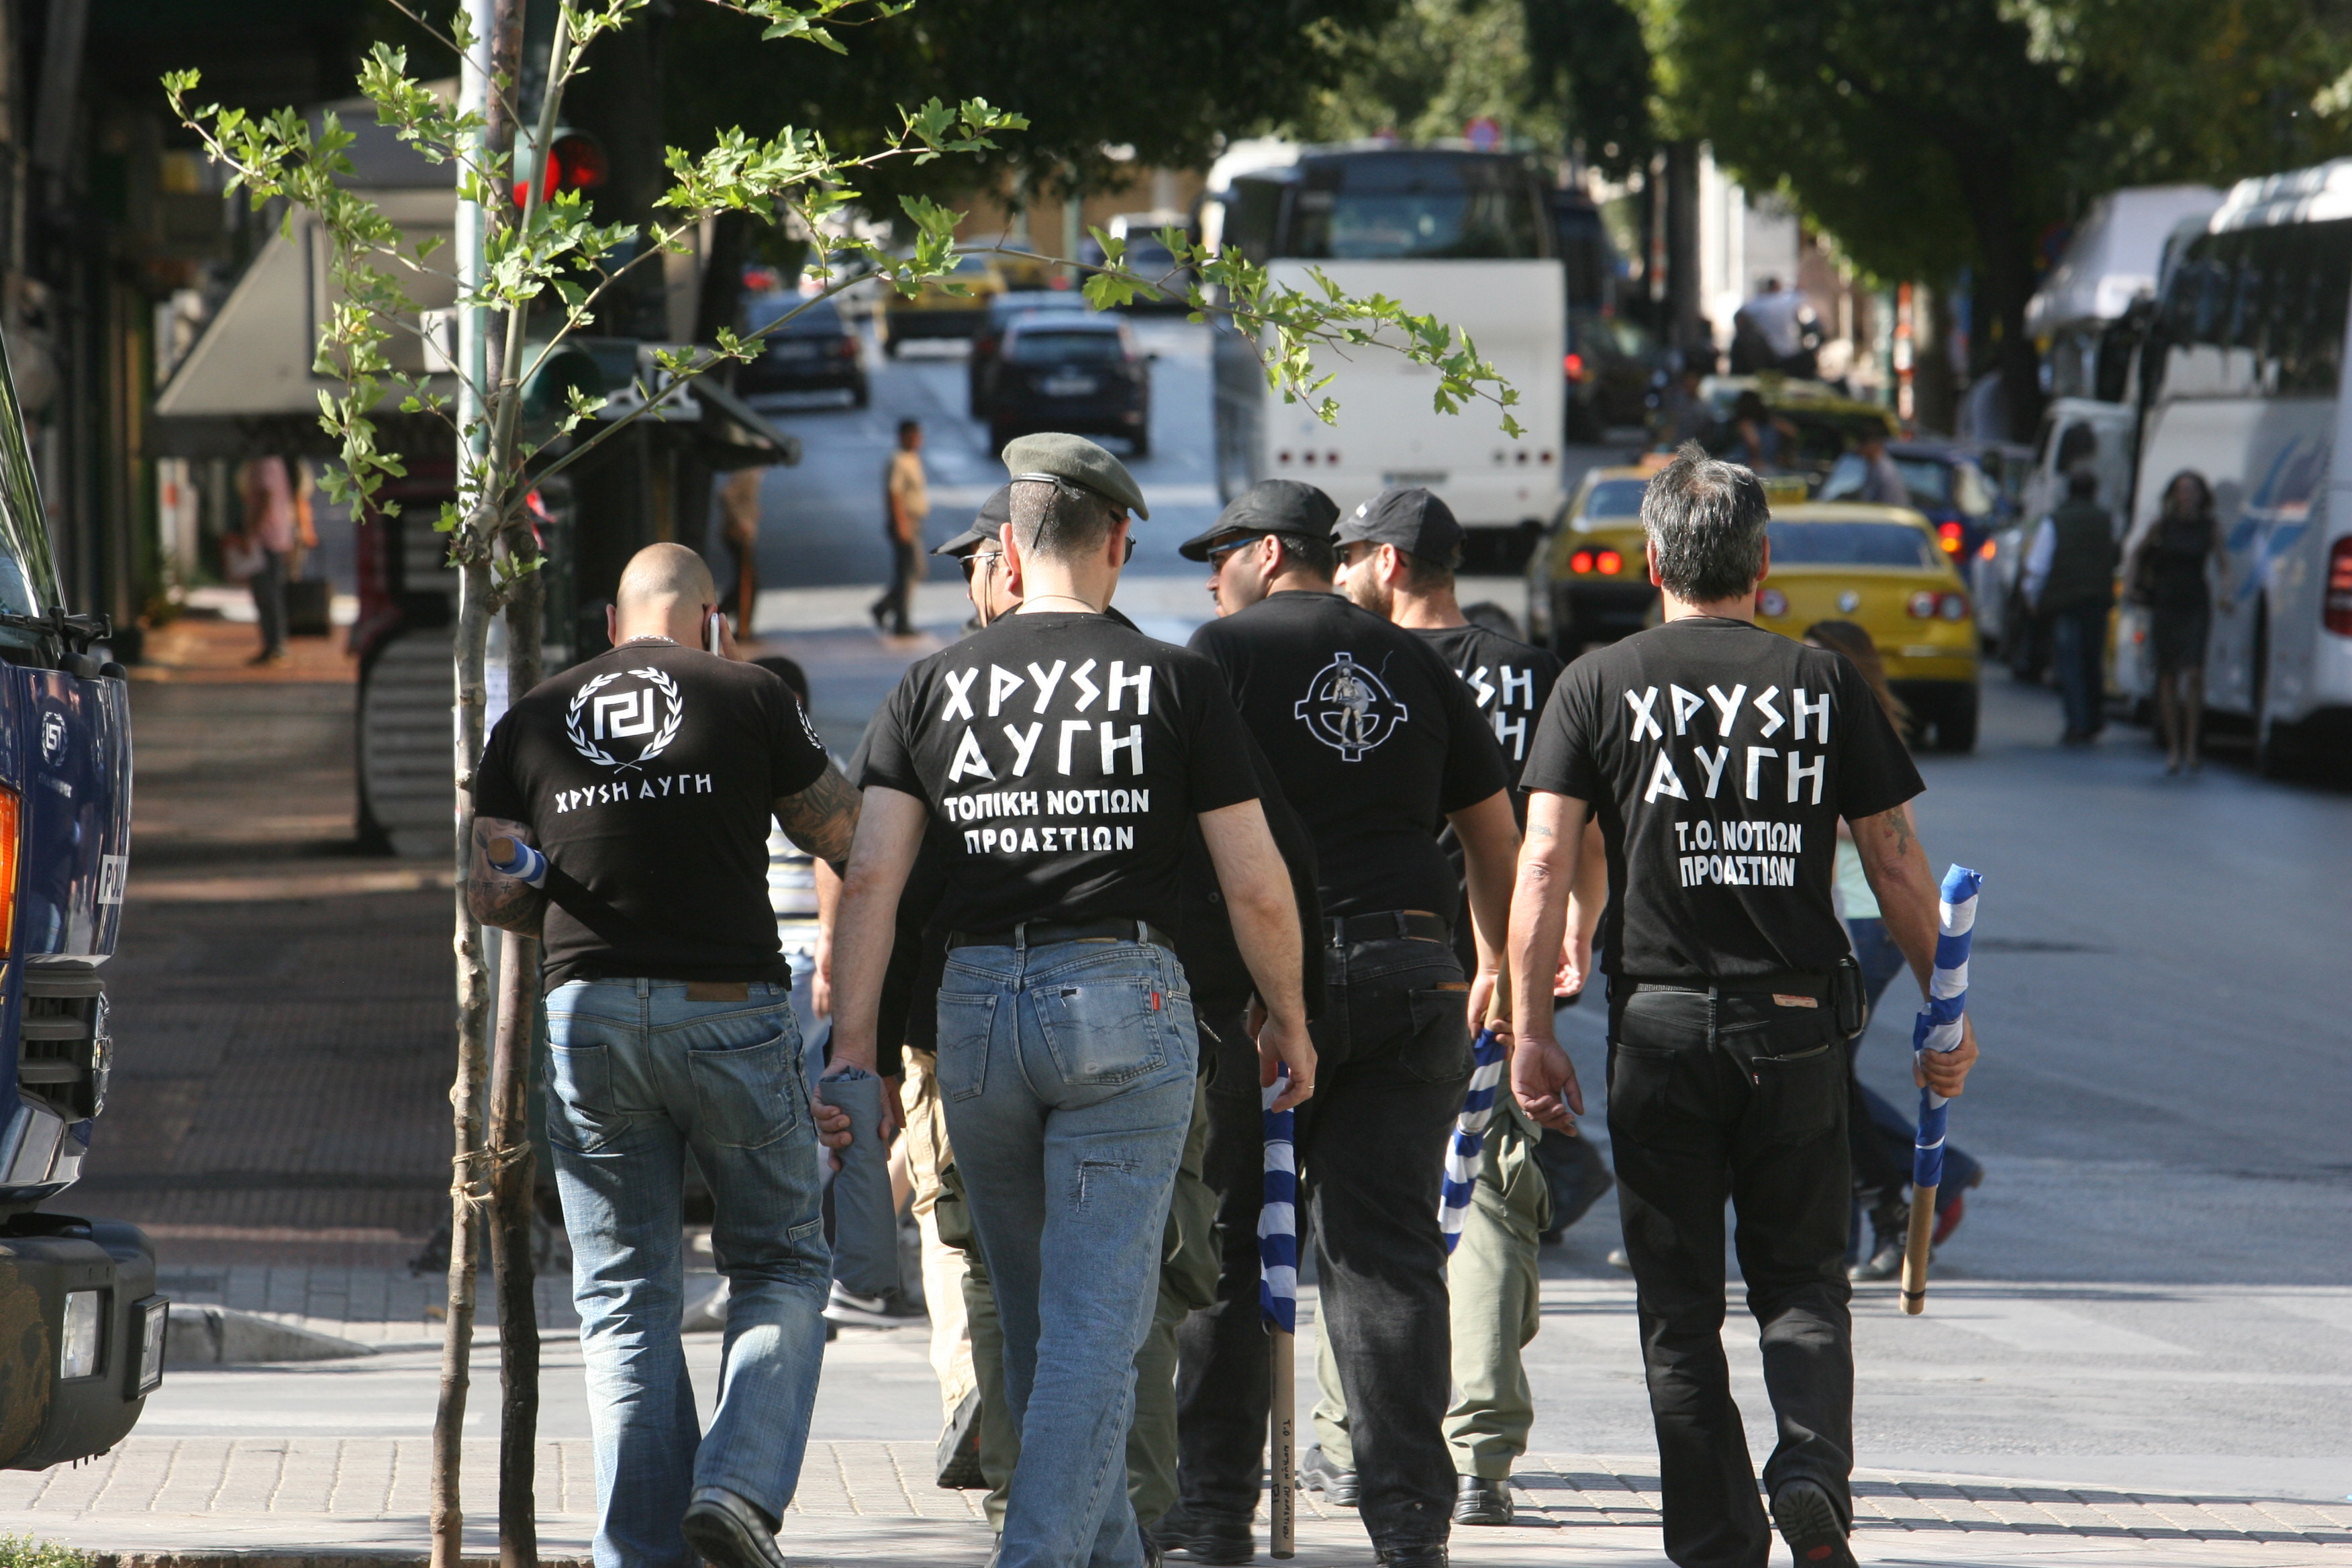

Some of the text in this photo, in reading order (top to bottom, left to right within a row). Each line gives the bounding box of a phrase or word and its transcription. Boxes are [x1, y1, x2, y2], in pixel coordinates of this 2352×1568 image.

[948, 720, 1144, 783] ΑΥΓΗ
[639, 773, 712, 799] ΑΥΓΗ
[1644, 745, 1825, 805] ΑΥΓΗ
[943, 789, 1149, 822] ΤΟΠΙΚΗ ΝΟΤΙΩΝ
[964, 826, 1134, 854] ΠΡΟΑΣΤΙΩΝ
[1675, 820, 1802, 853] Τ.Ο. ΝΟΤΙΩΝ
[1679, 855, 1796, 887] ΠΡΟΑΣΤΙΩΝ
